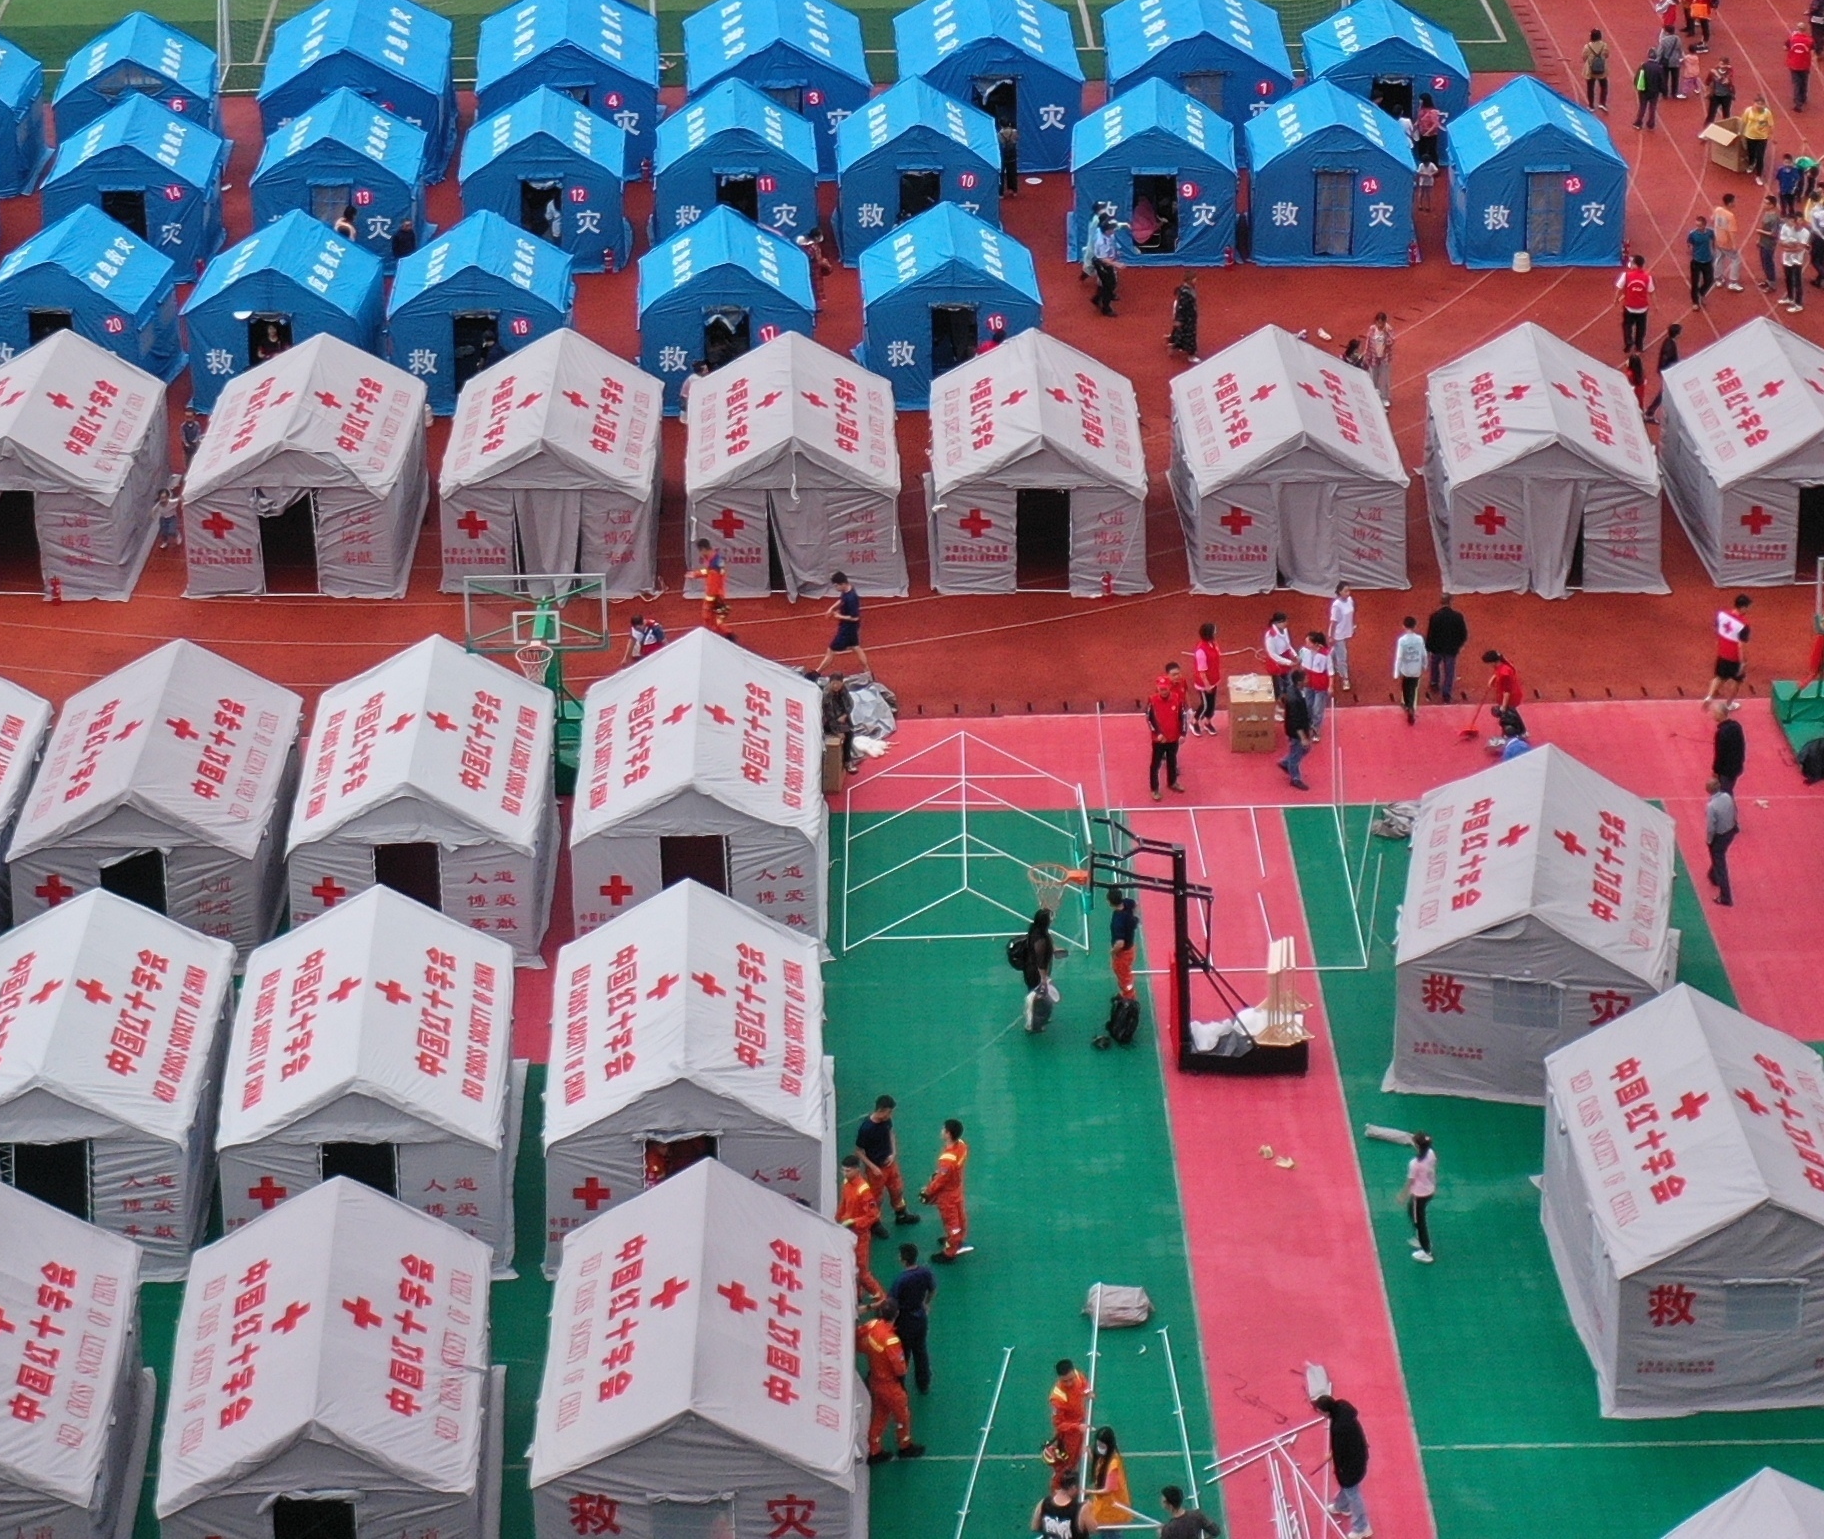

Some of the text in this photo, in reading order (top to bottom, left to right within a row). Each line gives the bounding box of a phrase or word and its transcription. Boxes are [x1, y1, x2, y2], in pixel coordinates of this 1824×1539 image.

[608, 95, 618, 106] 4
[1039, 105, 1065, 129] 灾
[166, 187, 181, 200] 14
[356, 192, 369, 203] 13
[572, 190, 585, 201] 12
[760, 179, 772, 190] 11
[961, 175, 974, 187] 10
[1183, 184, 1193, 197] 9
[1193, 203, 1216, 227] 灾
[1273, 202, 1394, 227] 救 灾
[1363, 179, 1378, 193] 24
[1484, 203, 1605, 229] 救 灾
[1566, 178, 1581, 191] 23
[576, 211, 602, 234] 灾
[106, 318, 122, 333] 20
[513, 321, 527, 334] 18
[988, 316, 1003, 329] 16
[409, 349, 437, 374] 救
[64, 379, 120, 456] 中国红十字会
[231, 377, 275, 455] 中国红十字会
[336, 376, 384, 454] 中国红十字会
[482, 375, 517, 456] 中国红十字会
[589, 376, 625, 455] 中国红十字会
[834, 377, 859, 454] 中国红十字会
[1213, 372, 1254, 450] 中国红十字会
[1712, 366, 1770, 449] 中国红十字会
[191, 697, 248, 800] 中国红十字会
[340, 691, 385, 795] 中国红十字会
[459, 689, 503, 791] 中国红十字会
[622, 685, 658, 786] 中国红十字会
[741, 681, 773, 785] 中国红十字会
[1450, 796, 1495, 911] 中国红十字会
[1589, 809, 1628, 922] 中国红十字会
[106, 949, 170, 1075] 中国红十字会
[280, 949, 326, 1079] 中国红十字会
[415, 947, 457, 1076] 中国红十字会
[468, 1004, 492, 1047] SOCIETY
[472, 989, 495, 1006] OF
[603, 944, 640, 1079] 中国红十字会
[733, 942, 769, 1068] 中国红十字会
[1422, 973, 1631, 1026] 救 灾
[461, 1076, 486, 1101] RED
[464, 1045, 489, 1081] CROSS
[1613, 1057, 1687, 1204] 中国红十字会
[9, 1261, 79, 1423] 中国红十字会
[386, 1254, 437, 1416] 中国红十字会
[597, 1234, 648, 1402] 中国红十字会
[763, 1238, 805, 1405] 中国红十字会
[814, 1254, 844, 1431] RED CROSS SOCIETY OF CHINA
[1648, 1283, 1697, 1326] 救
[54, 1272, 119, 1450] RED CROSS SOCIETY OF CHINA
[218, 1259, 271, 1428] 中国红十字会
[569, 1492, 817, 1538] 救 灾
